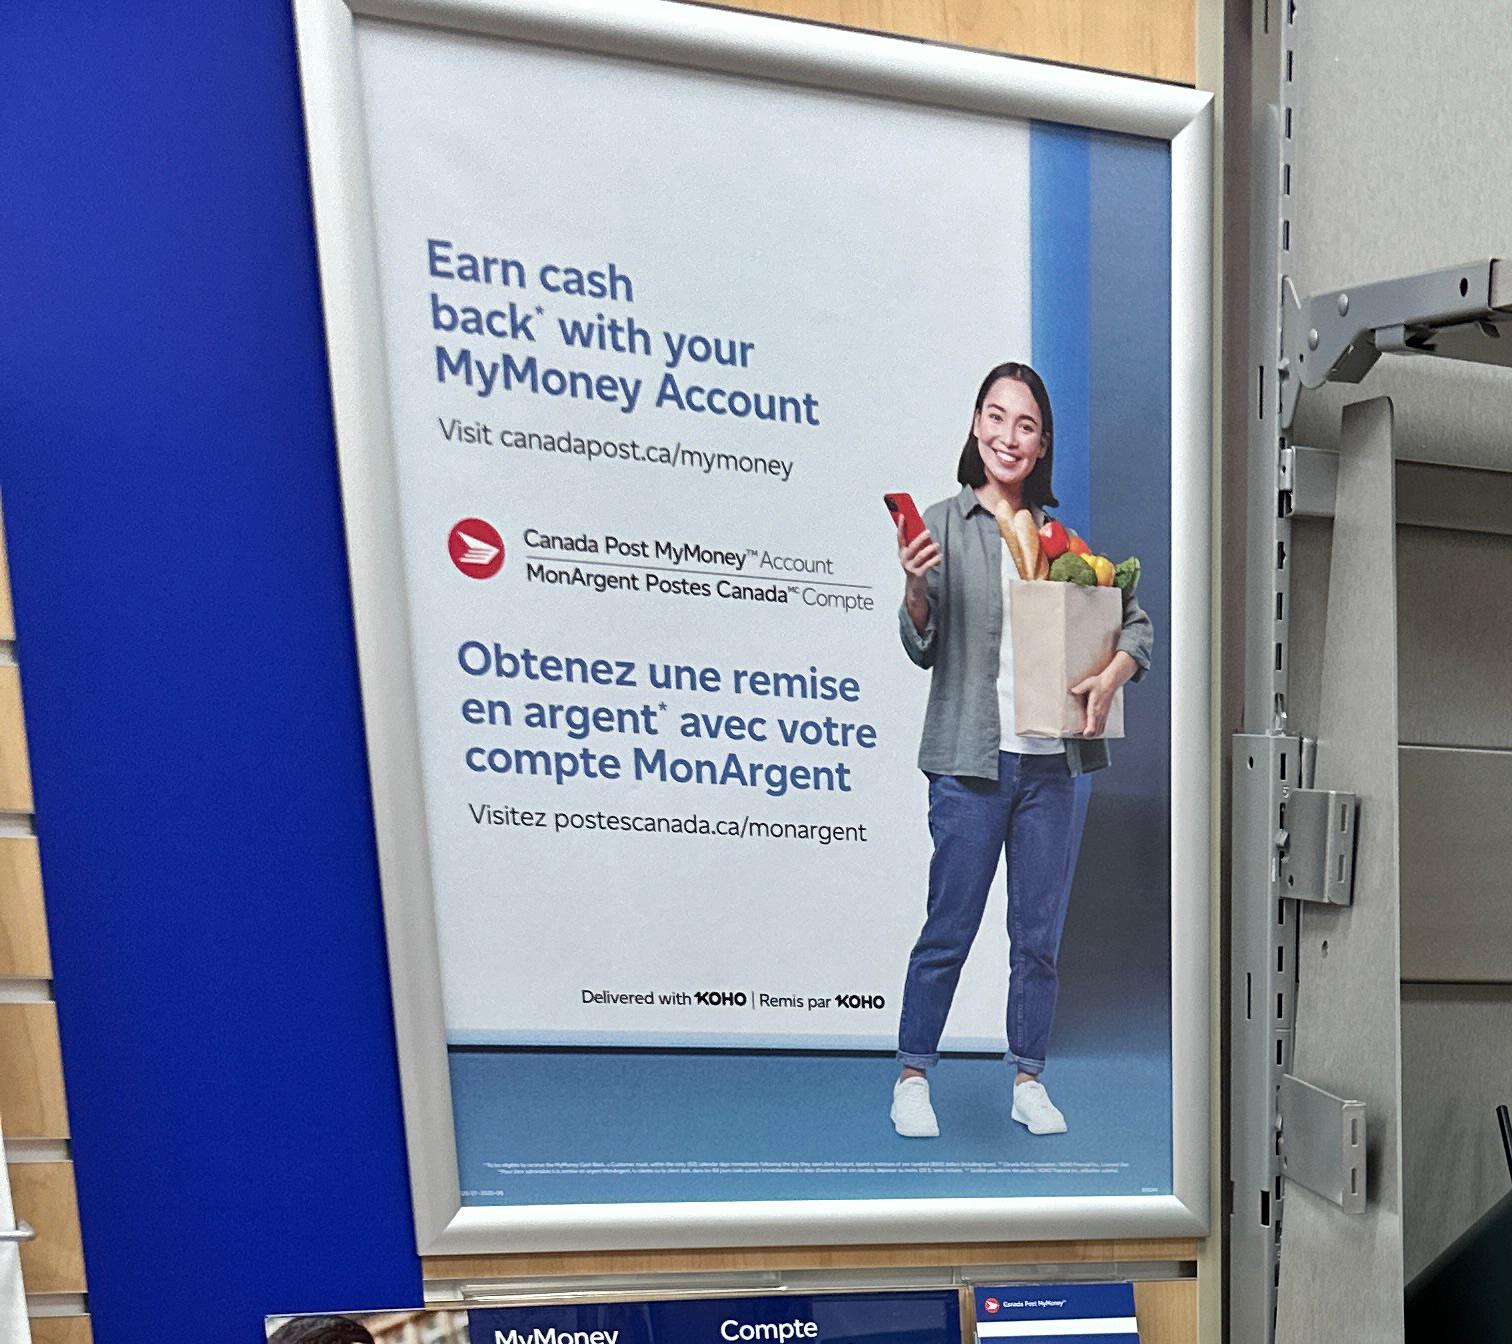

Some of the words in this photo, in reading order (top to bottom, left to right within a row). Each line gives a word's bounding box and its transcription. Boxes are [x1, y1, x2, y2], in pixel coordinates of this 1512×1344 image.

[427, 240, 526, 287] Earn
[540, 263, 634, 300] cash
[559, 314, 651, 354] with
[663, 332, 755, 368] your
[435, 348, 641, 413] MyMoney
[655, 373, 820, 425] Account
[438, 416, 492, 446] Visit
[500, 428, 794, 482] canadapost.ca/mymoney
[523, 529, 598, 557] Canada
[605, 535, 649, 561] Post
[759, 546, 834, 574] Account
[526, 563, 639, 595] MonArgent
[645, 572, 711, 598] Postes
[802, 585, 874, 614] Compte
[457, 641, 636, 686] Obtenez
[648, 662, 721, 691] une
[733, 662, 861, 699] remise
[461, 700, 513, 726] en
[680, 713, 767, 740] avec
[777, 715, 878, 747] votre
[465, 748, 621, 784] compte
[633, 748, 852, 795] MonArgent
[469, 803, 547, 829] Visitez
[554, 810, 868, 845] postescanada.ca/monargent
[581, 990, 654, 1005] Delivered
[659, 992, 692, 1006] with
[759, 993, 804, 1008] Remis
[808, 998, 831, 1012] par
[720, 1318, 818, 1344] Compte
